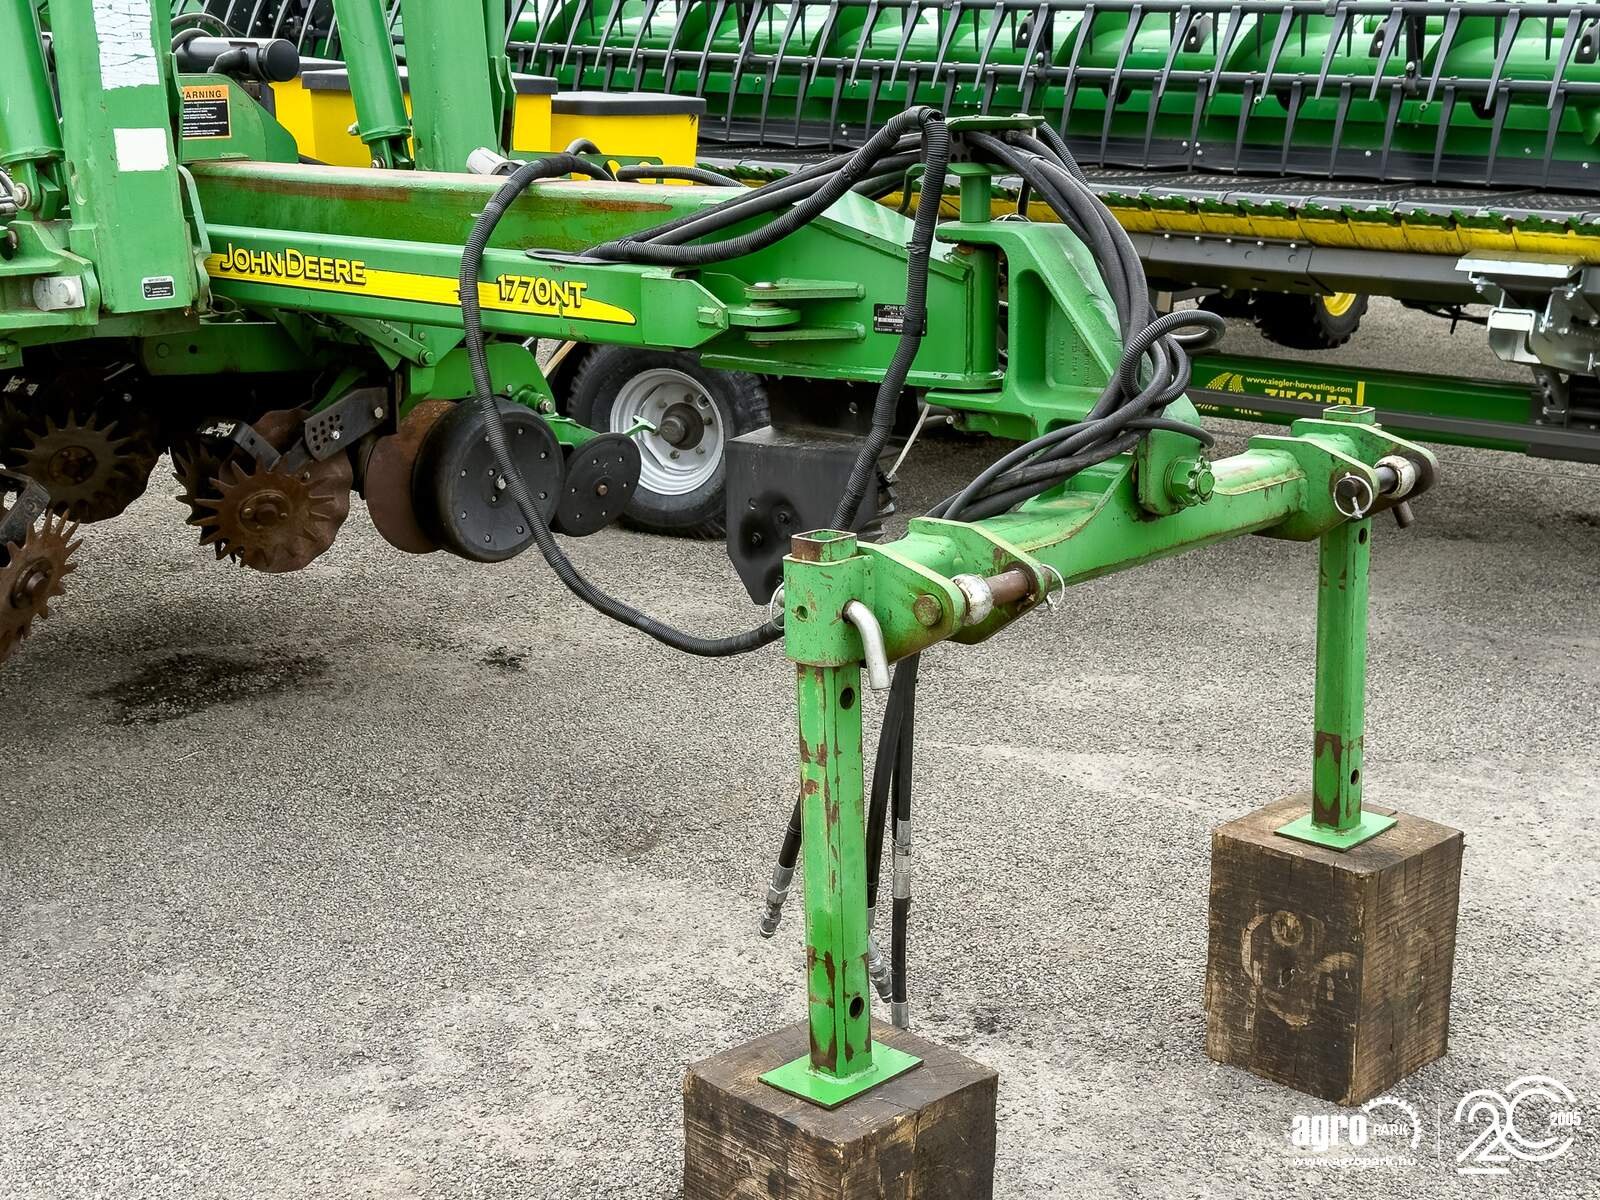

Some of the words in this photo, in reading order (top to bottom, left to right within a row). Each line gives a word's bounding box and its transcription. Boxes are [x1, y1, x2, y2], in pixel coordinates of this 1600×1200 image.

[182, 90, 222, 99] ARNING
[220, 242, 282, 276] JOHN
[285, 248, 366, 286] DEERE
[496, 273, 587, 308] 1770NT
[1245, 376, 1353, 393] www.ziegler-harvesting.com
